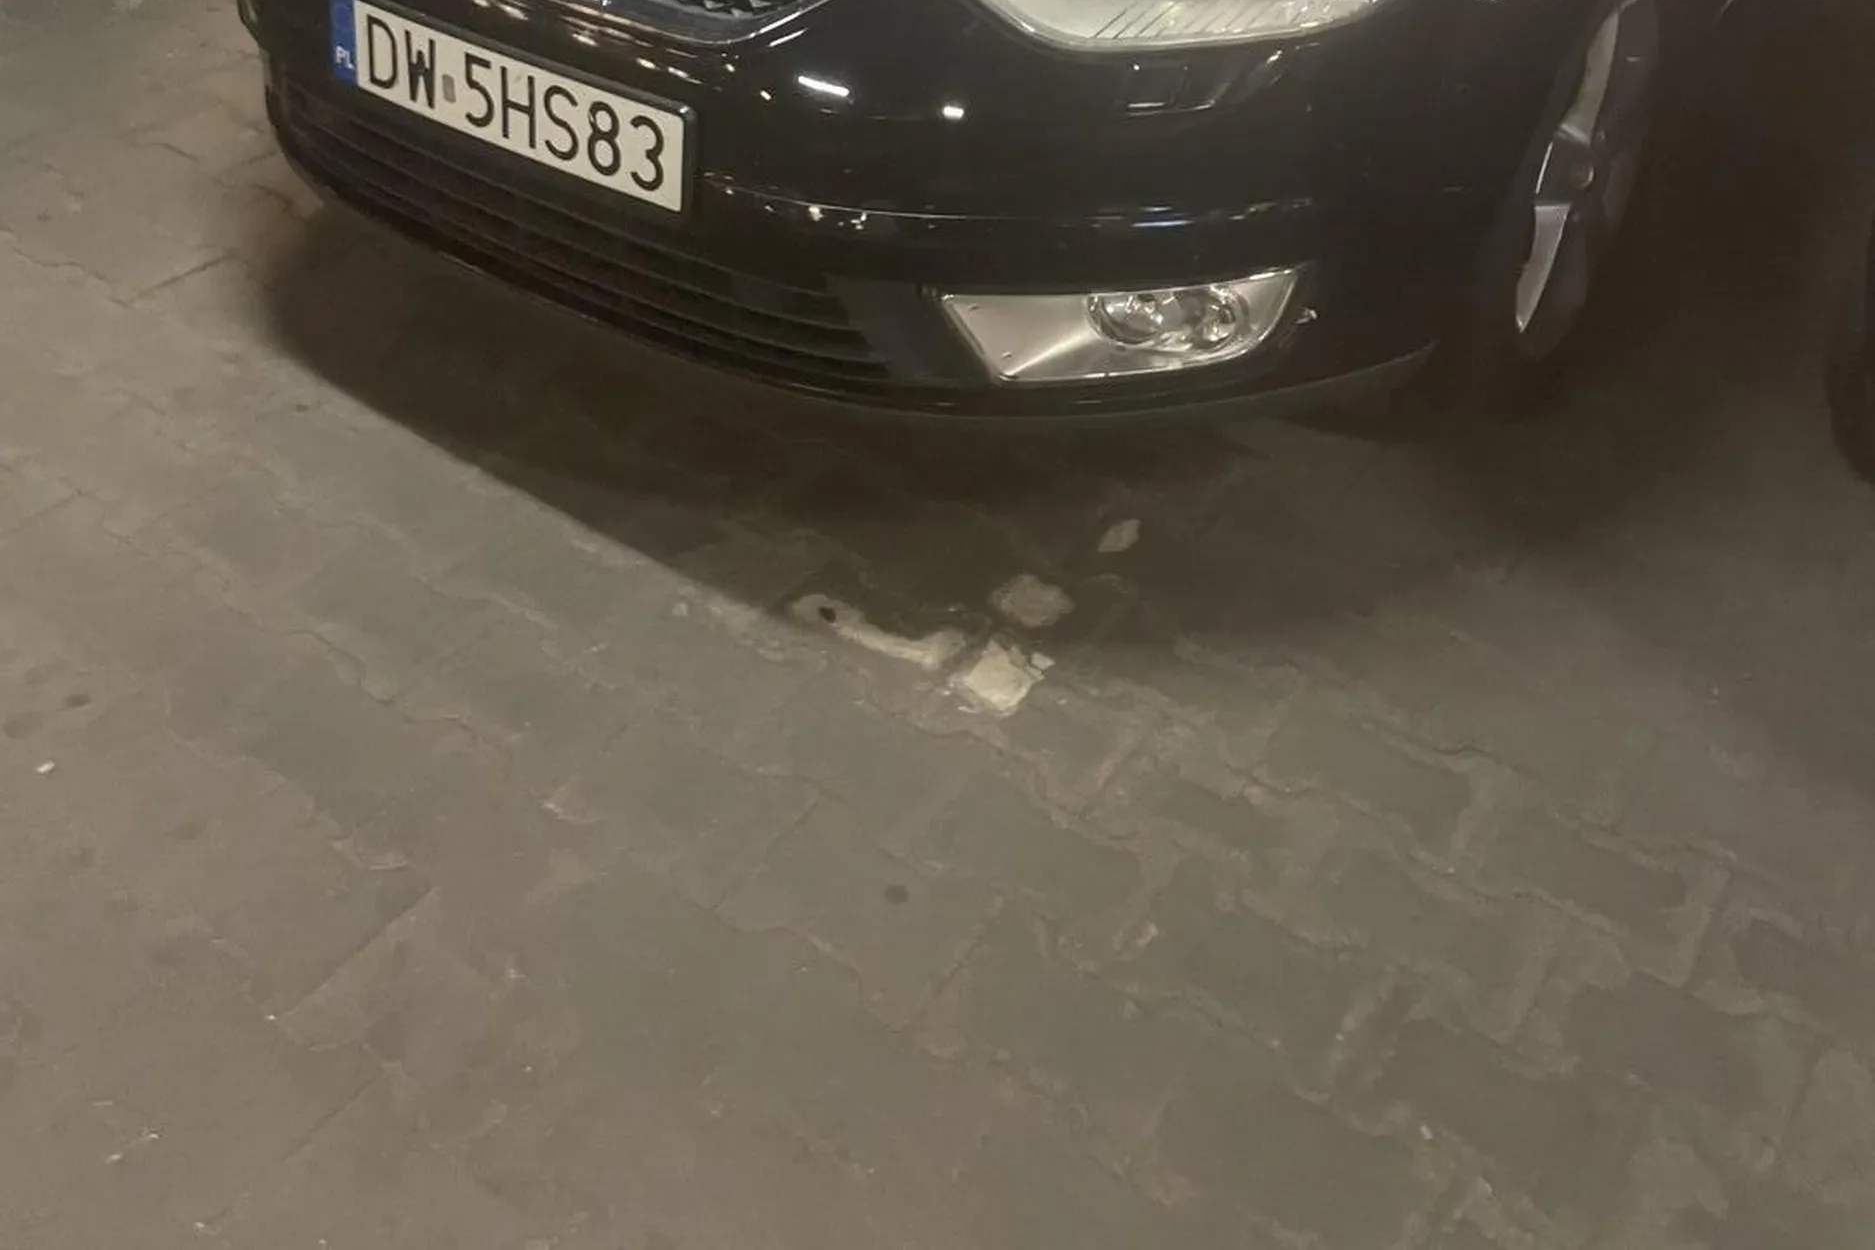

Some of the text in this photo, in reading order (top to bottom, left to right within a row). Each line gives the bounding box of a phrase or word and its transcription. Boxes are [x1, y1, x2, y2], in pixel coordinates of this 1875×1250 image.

[335, 45, 356, 70] PL
[366, 14, 665, 192] DW 5HS83
